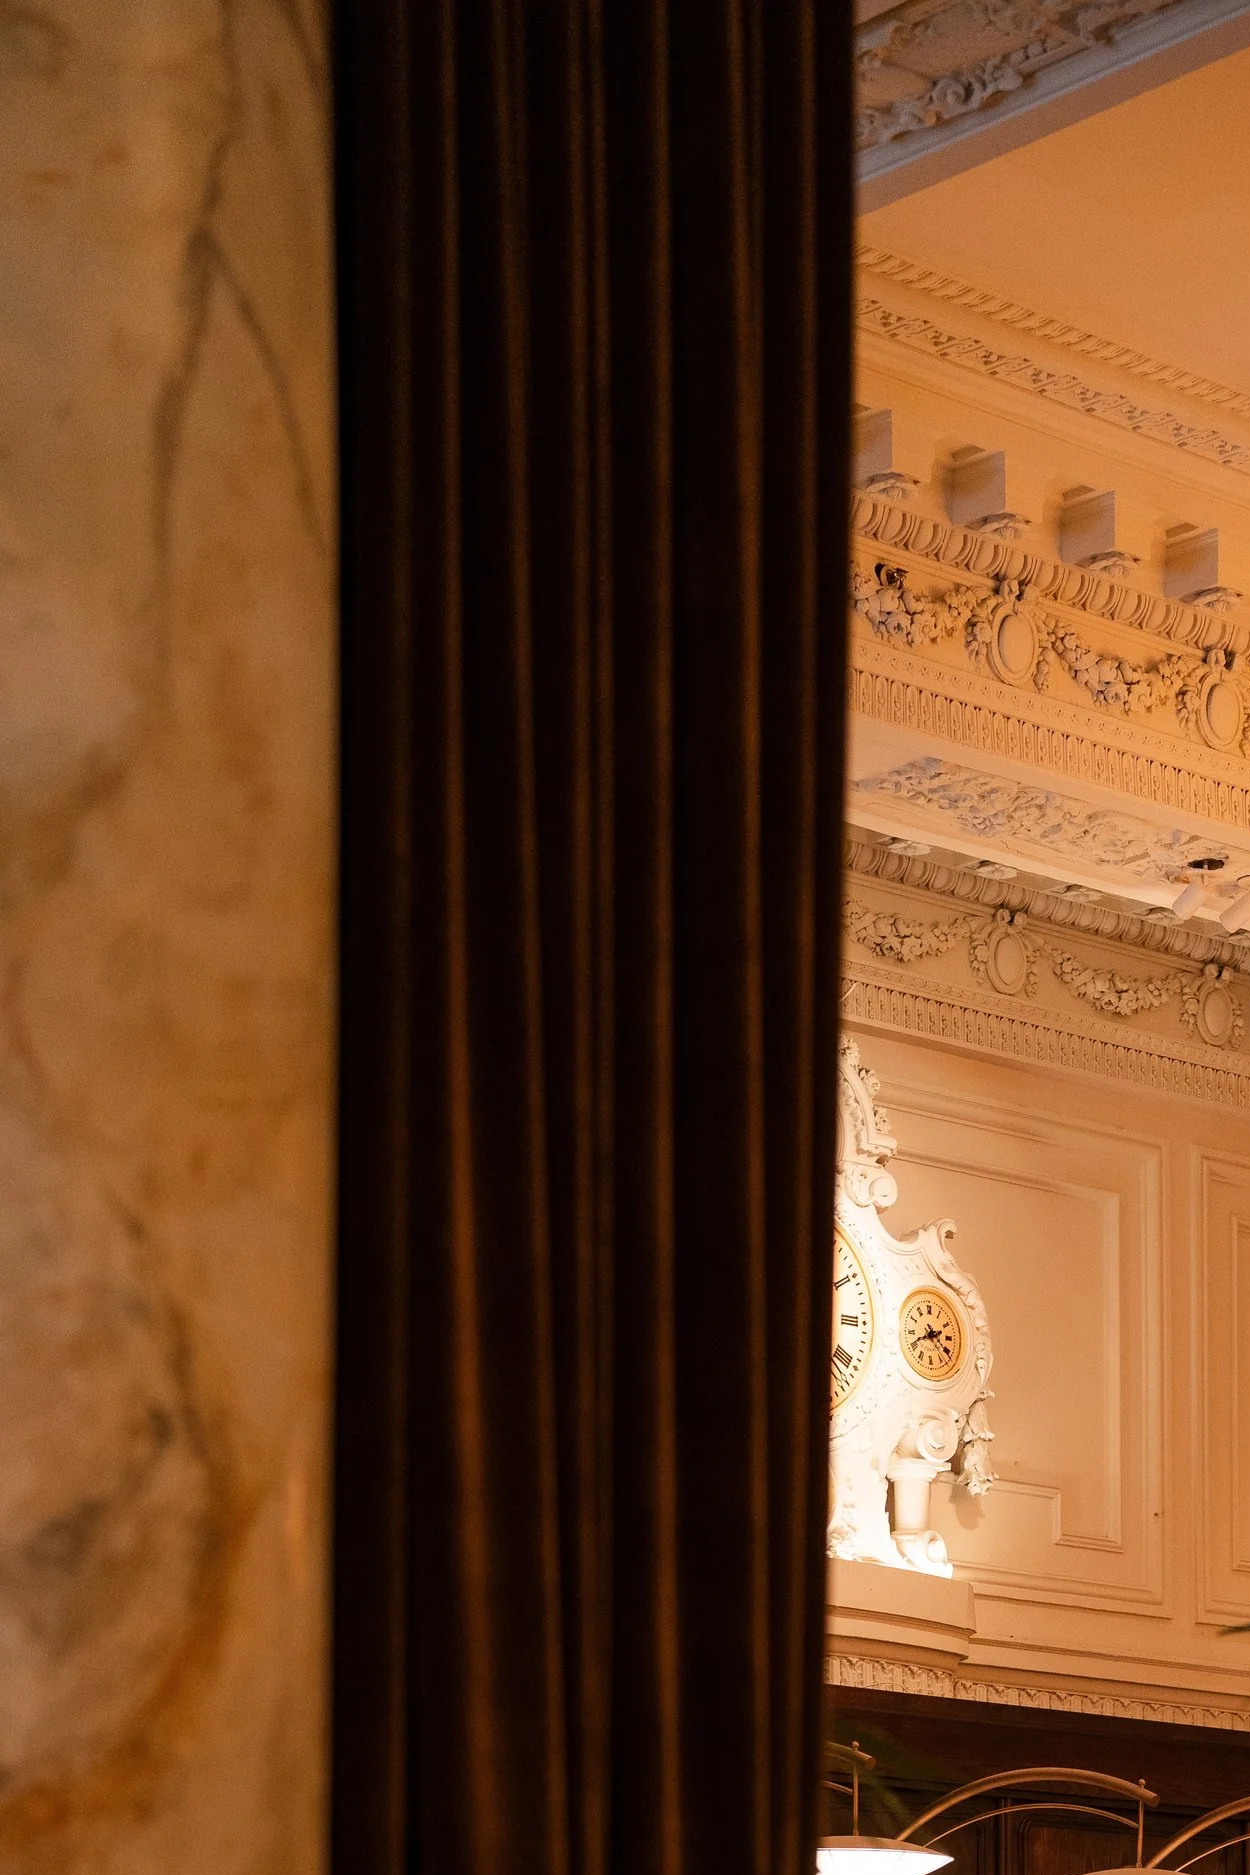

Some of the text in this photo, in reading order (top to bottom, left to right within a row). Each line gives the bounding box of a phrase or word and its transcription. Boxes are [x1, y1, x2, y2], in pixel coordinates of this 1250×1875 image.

[832, 1274, 850, 1291] II
[841, 1314, 858, 1327] III
[833, 1344, 853, 1369] IIII
